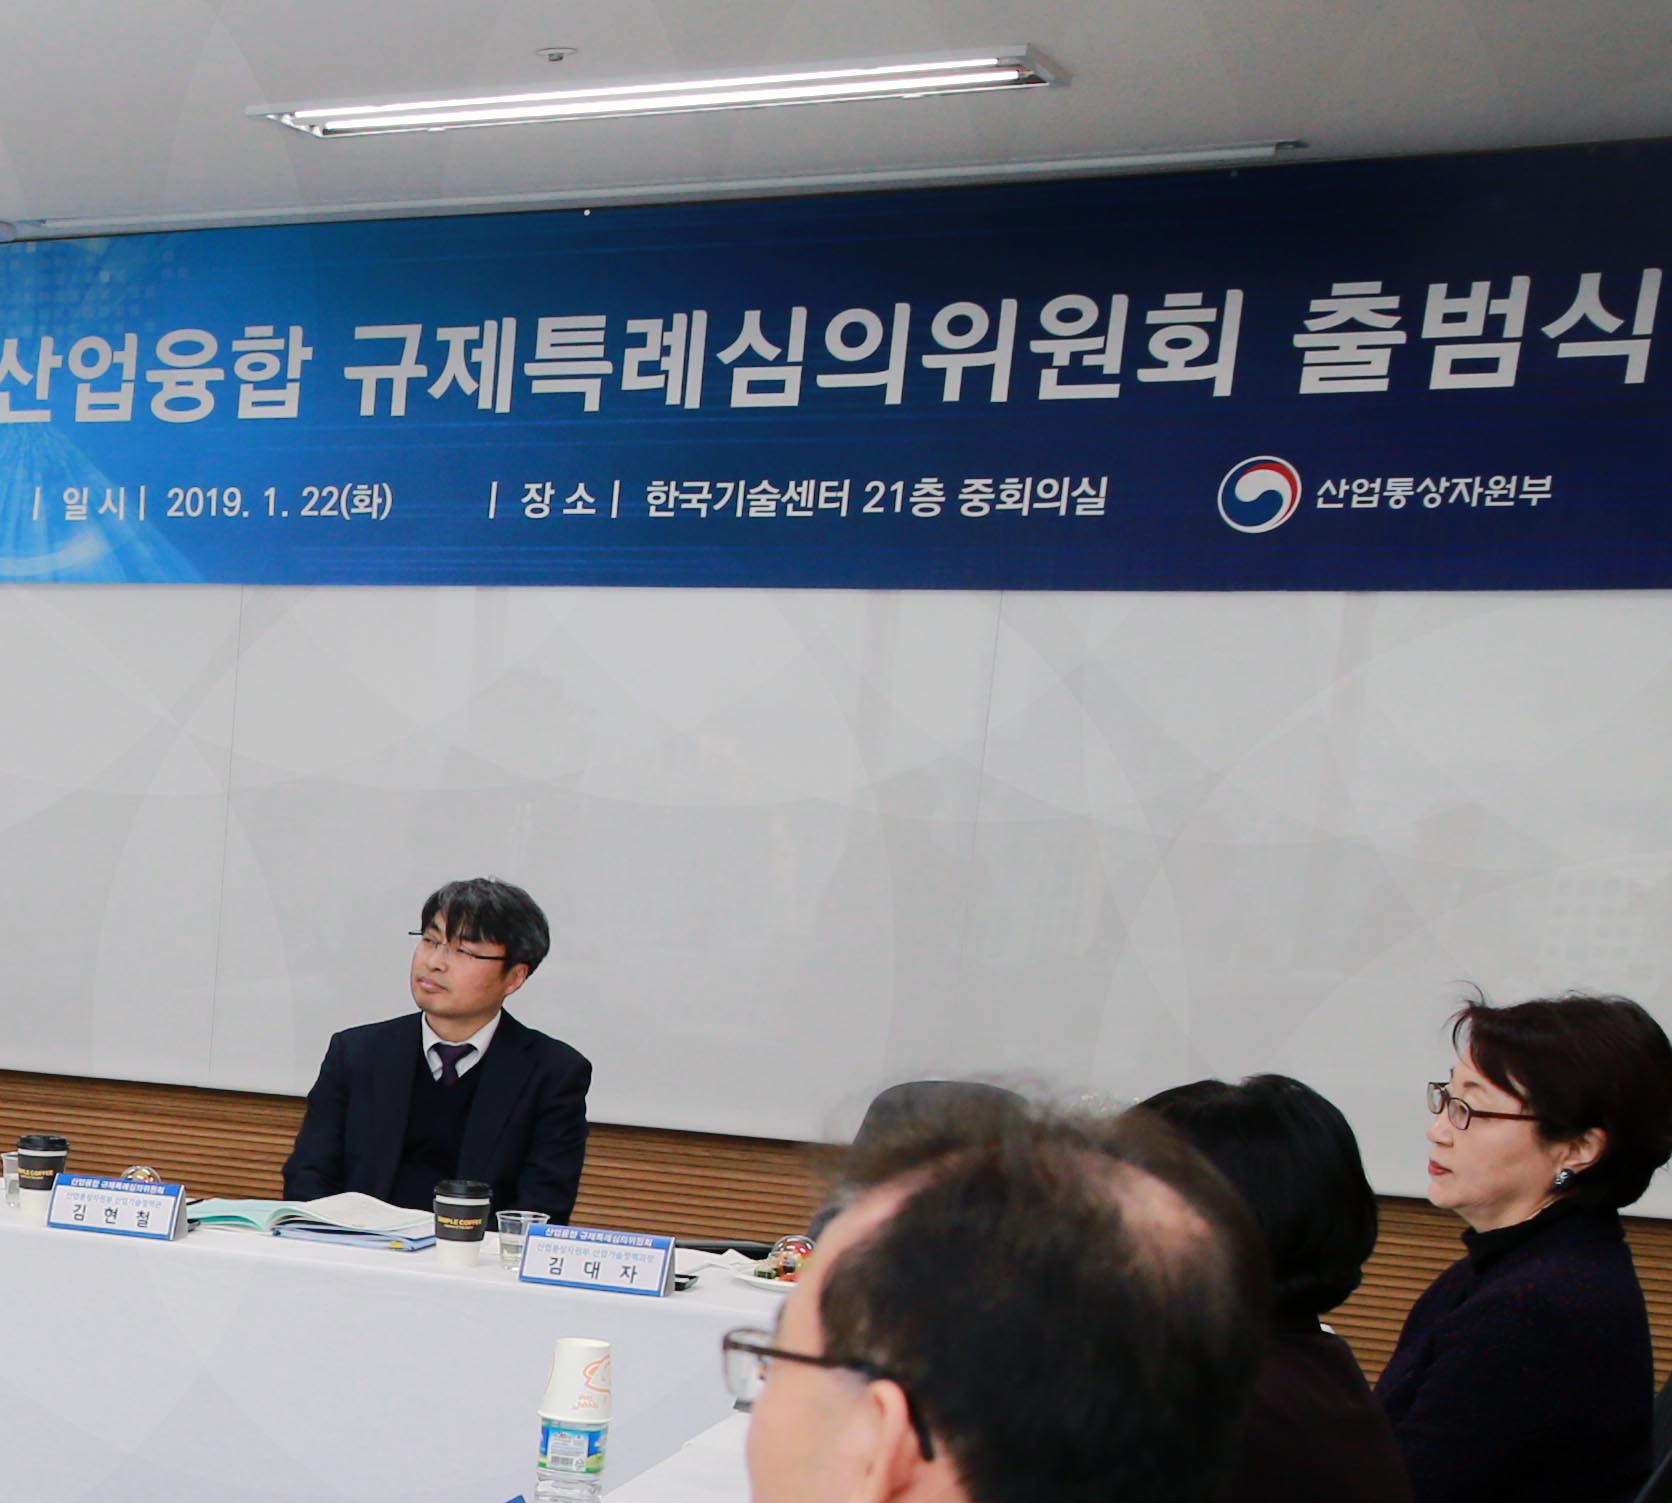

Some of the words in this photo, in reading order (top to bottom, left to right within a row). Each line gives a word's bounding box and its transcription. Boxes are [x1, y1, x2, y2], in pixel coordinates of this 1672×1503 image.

[344, 288, 1244, 416] 규제특례심의위원회
[1293, 268, 1663, 394] 출범식
[168, 487, 250, 519] 2019.
[301, 482, 393, 520] 22(화)
[647, 478, 850, 518] 한국기술센터
[864, 478, 946, 516] 21층
[958, 475, 1108, 518] 중회의실
[1317, 474, 1554, 511] 산업통상자원부
